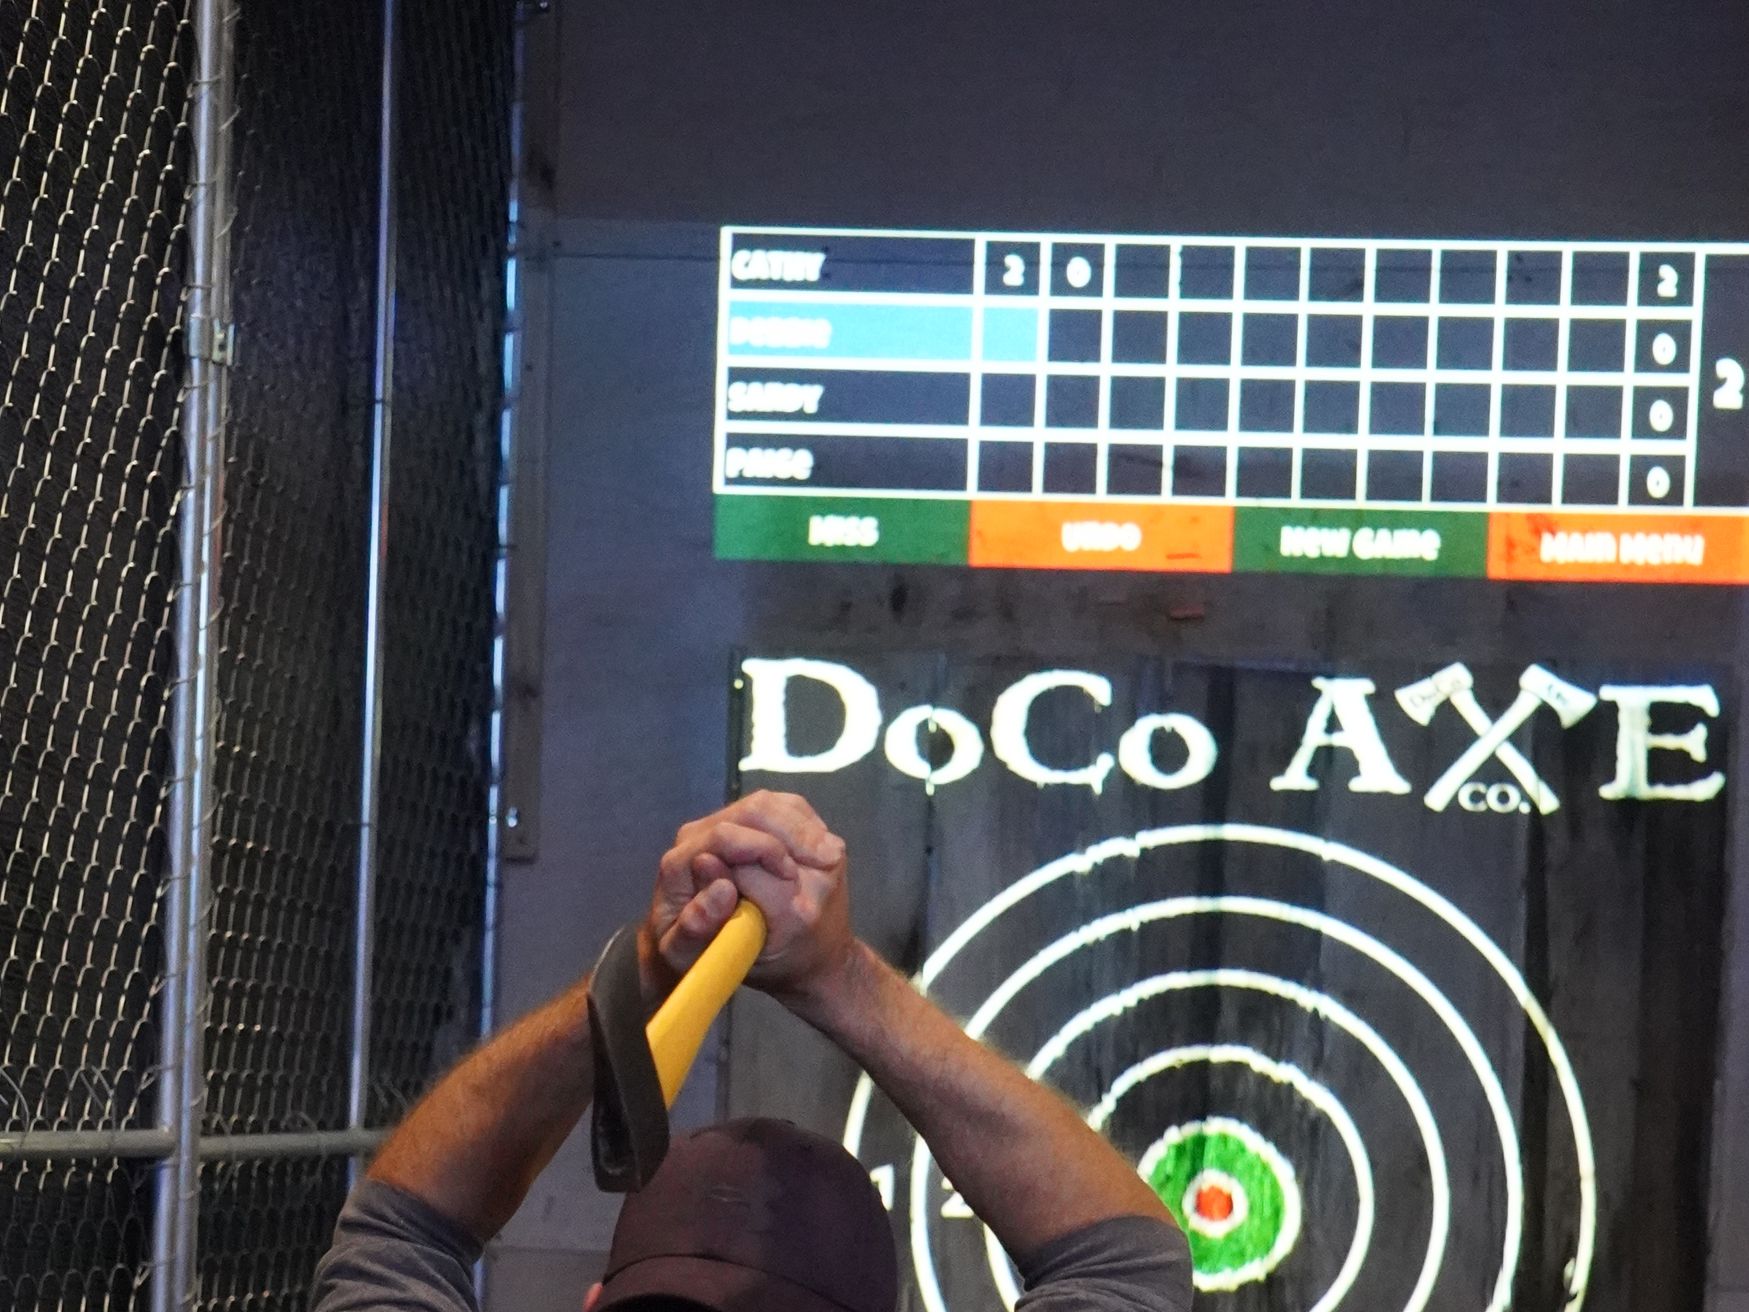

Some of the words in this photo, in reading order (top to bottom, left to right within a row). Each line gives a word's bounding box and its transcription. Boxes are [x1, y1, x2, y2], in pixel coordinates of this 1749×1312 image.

[1003, 254, 1026, 287] 2
[1066, 256, 1092, 289] 0
[1656, 264, 1679, 298] 2
[1651, 332, 1677, 366] 0
[1713, 357, 1746, 410] 2
[1648, 399, 1674, 432] 0
[1646, 466, 1671, 499] 0
